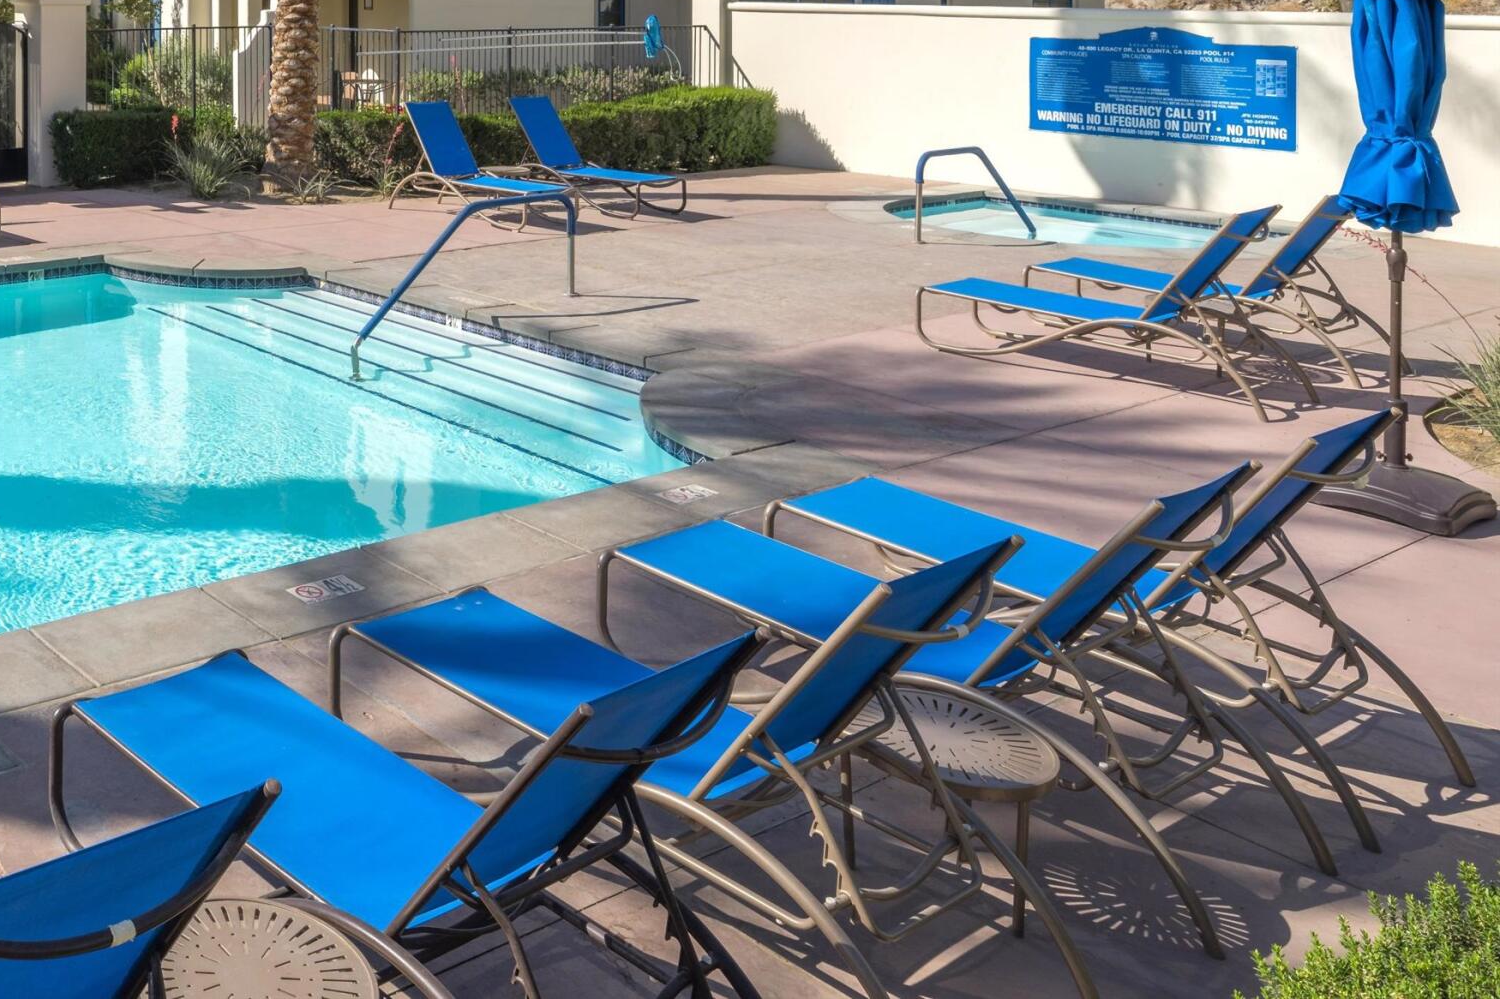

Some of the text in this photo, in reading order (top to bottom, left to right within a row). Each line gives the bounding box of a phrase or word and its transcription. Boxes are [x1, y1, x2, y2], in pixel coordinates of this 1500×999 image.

[1094, 102, 1162, 117] EMERGENCY
[1165, 107, 1194, 120] CALL
[1197, 109, 1217, 122] 911
[1037, 110, 1288, 140] WARNING NO LIFEGUARD ON DUTY NO DIVING
[1181, 132, 1209, 141] CAPACITY
[1232, 136, 1260, 145] CAPACITY
